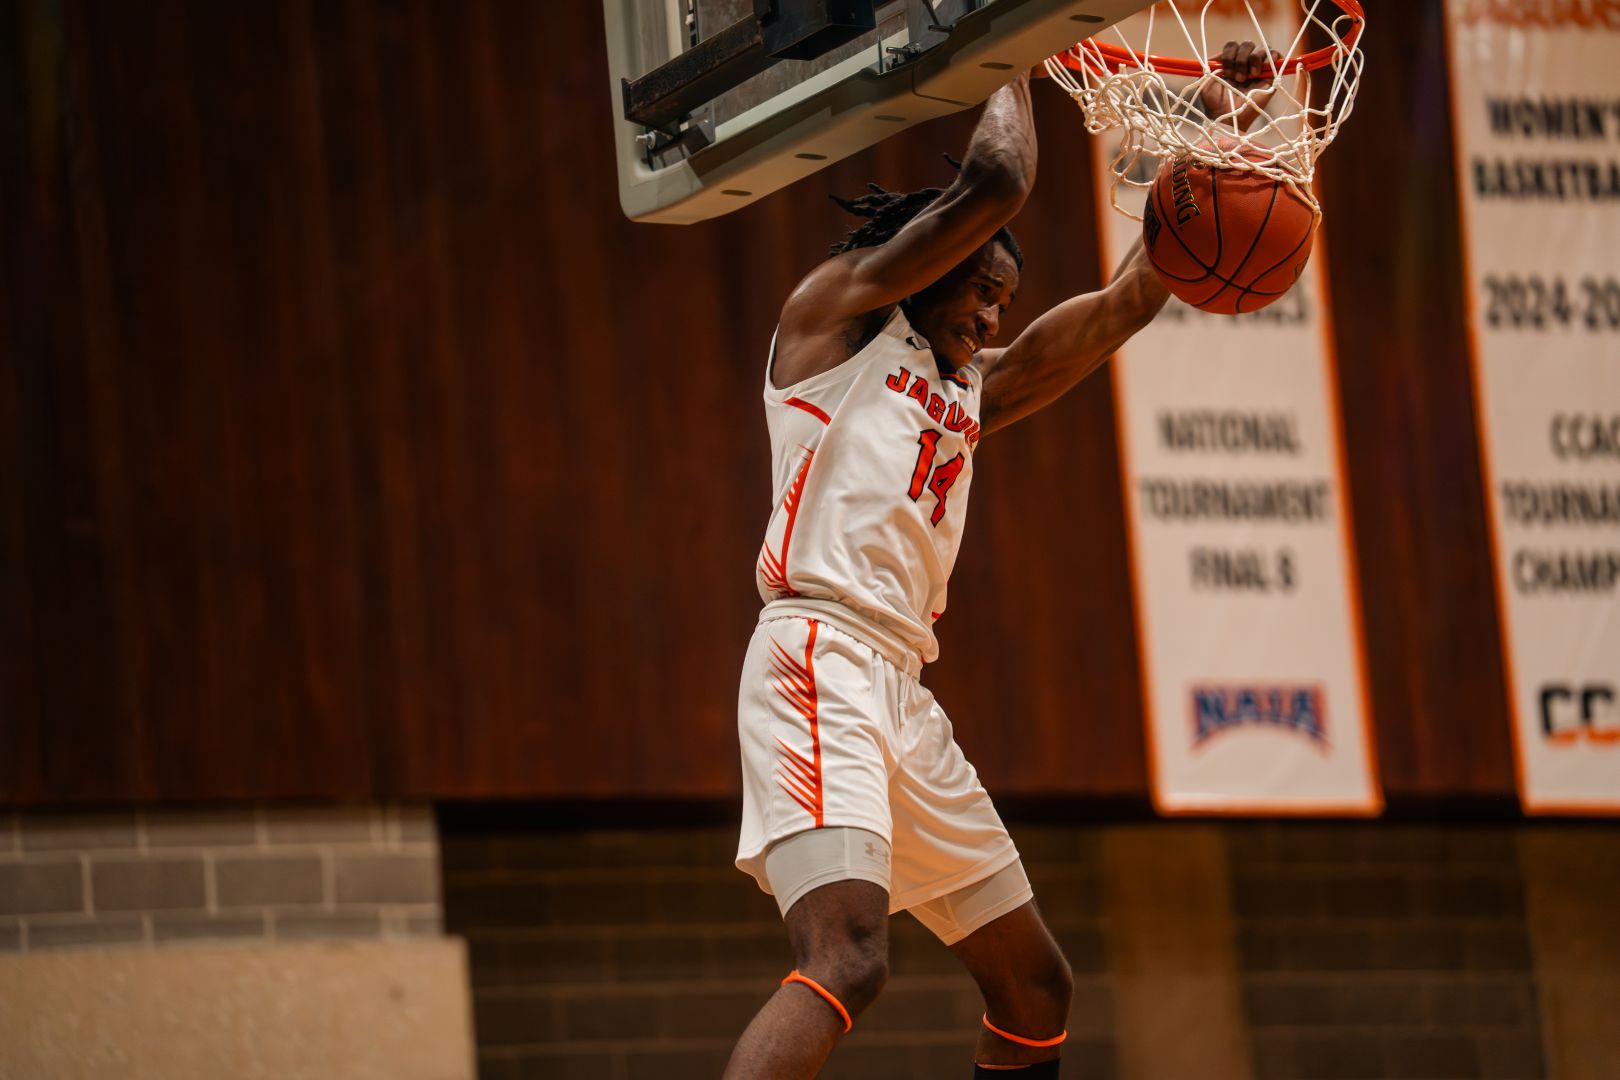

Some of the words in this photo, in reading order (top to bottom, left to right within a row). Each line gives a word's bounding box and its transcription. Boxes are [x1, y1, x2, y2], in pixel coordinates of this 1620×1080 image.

[1172, 157, 1201, 226] LDING
[1157, 409, 1302, 457] NATIONAL
[907, 428, 965, 528] 14
[1140, 478, 1329, 525] TOURNAMENT
[1189, 548, 1268, 593] FINAL
[1190, 684, 1331, 752] NAIA
